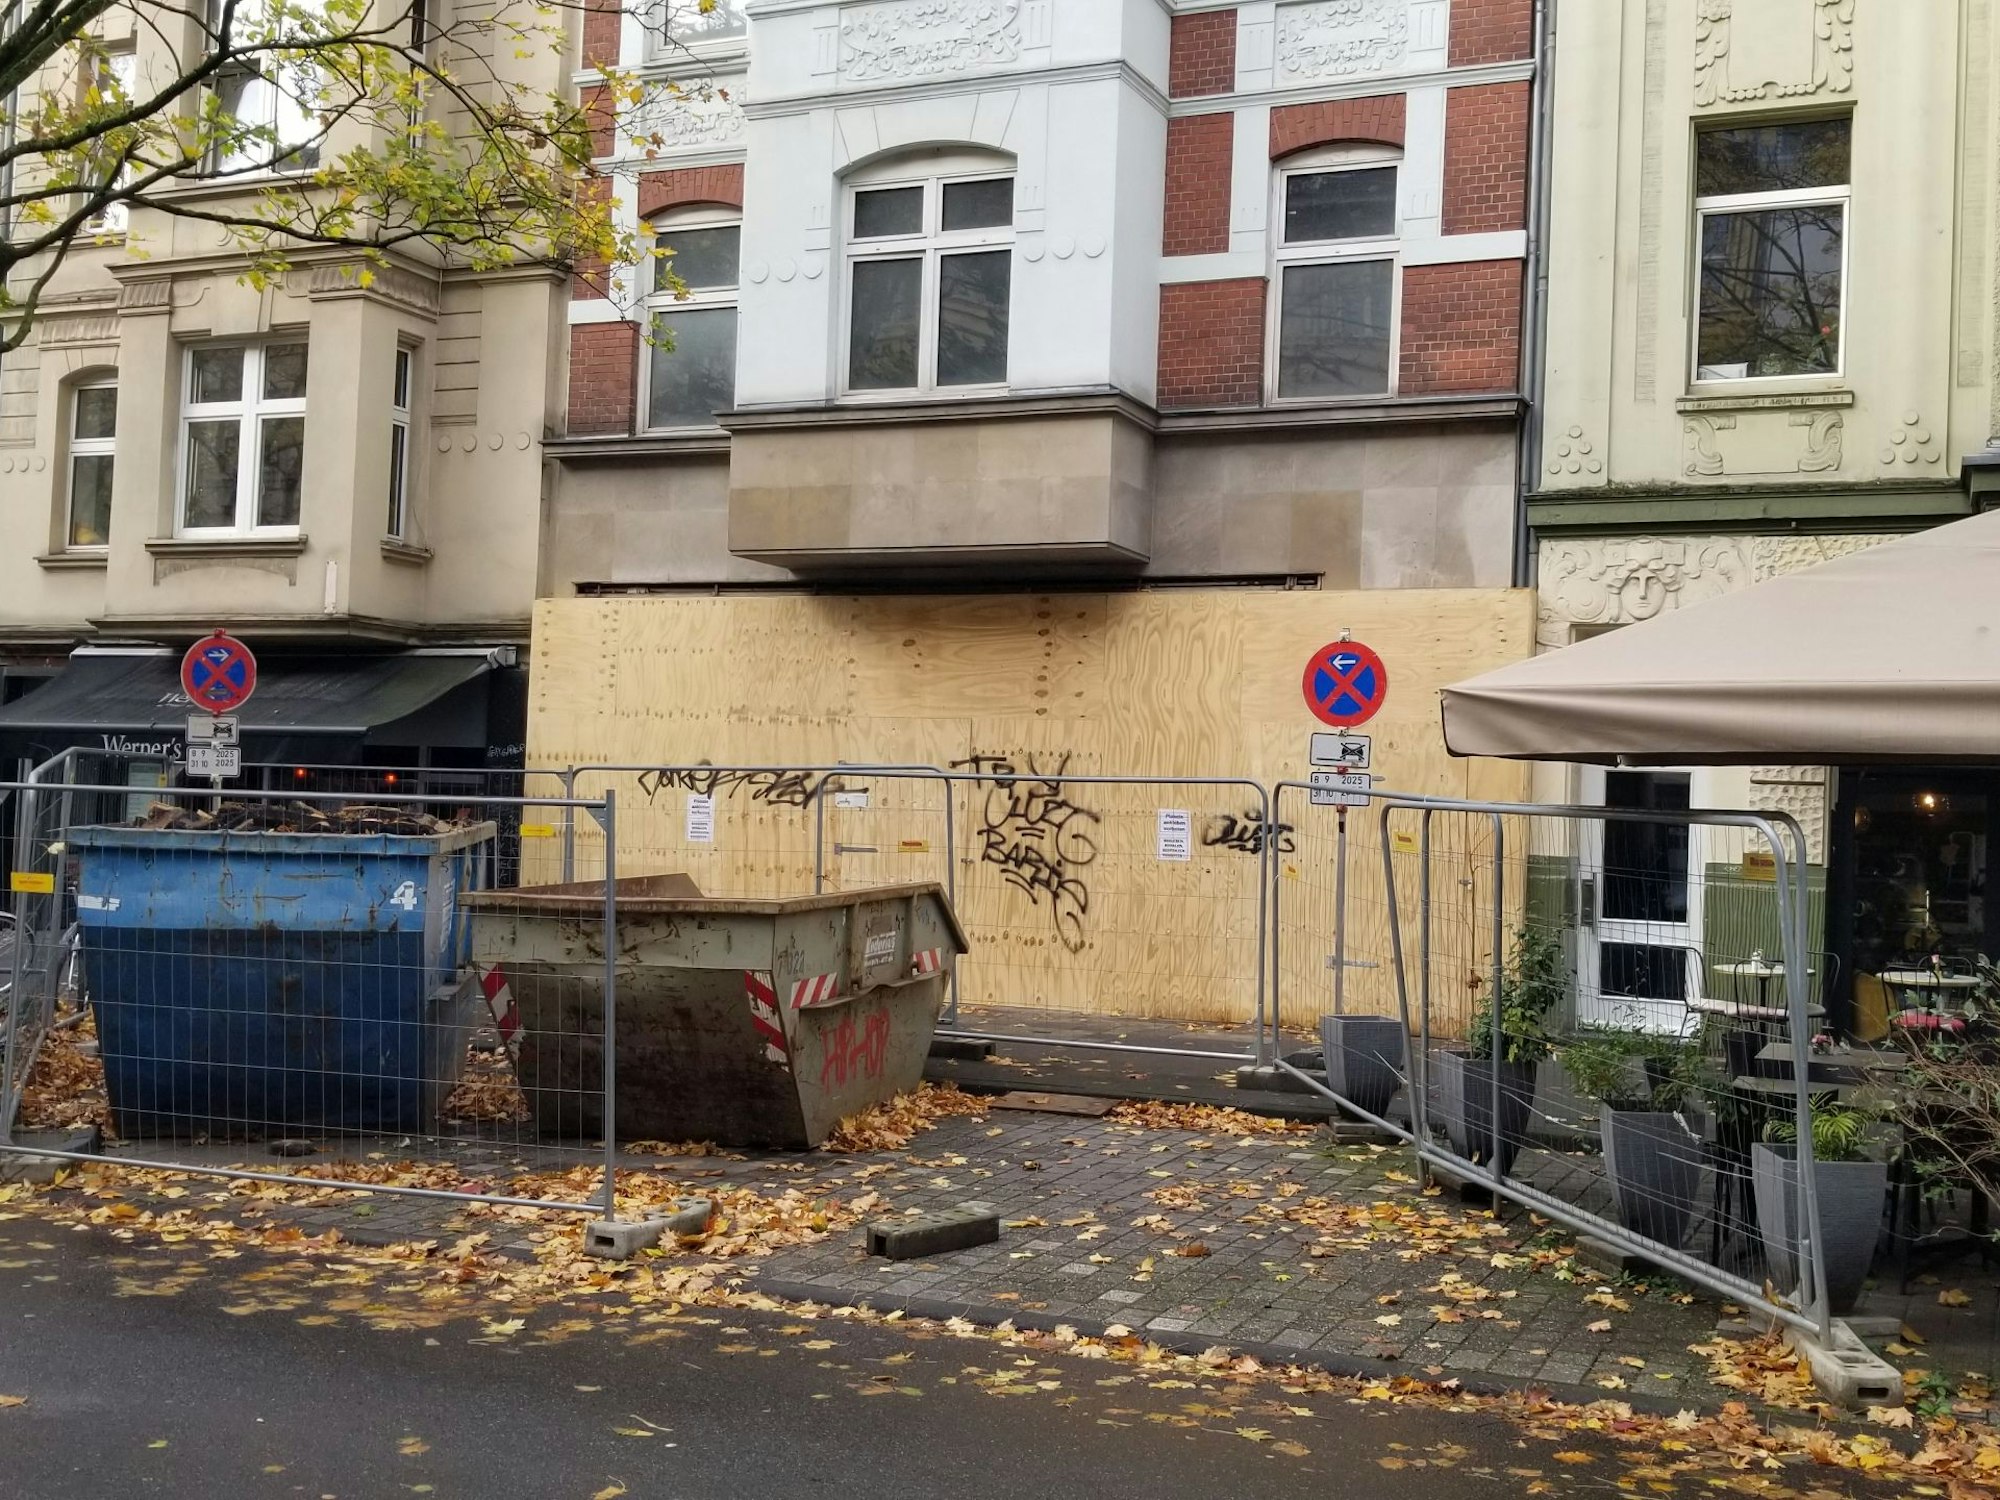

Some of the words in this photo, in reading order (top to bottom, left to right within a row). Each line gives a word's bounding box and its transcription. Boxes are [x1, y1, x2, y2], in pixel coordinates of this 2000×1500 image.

[101, 734, 182, 760] Werner's
[216, 750, 235, 758] 2025
[191, 760, 199, 768] 31
[201, 760, 209, 768] 10
[215, 759, 234, 767] 2025
[1313, 776, 1319, 784] 8
[1325, 776, 1330, 784] 9
[1341, 776, 1363, 785] 2025
[390, 881, 418, 910] 4
